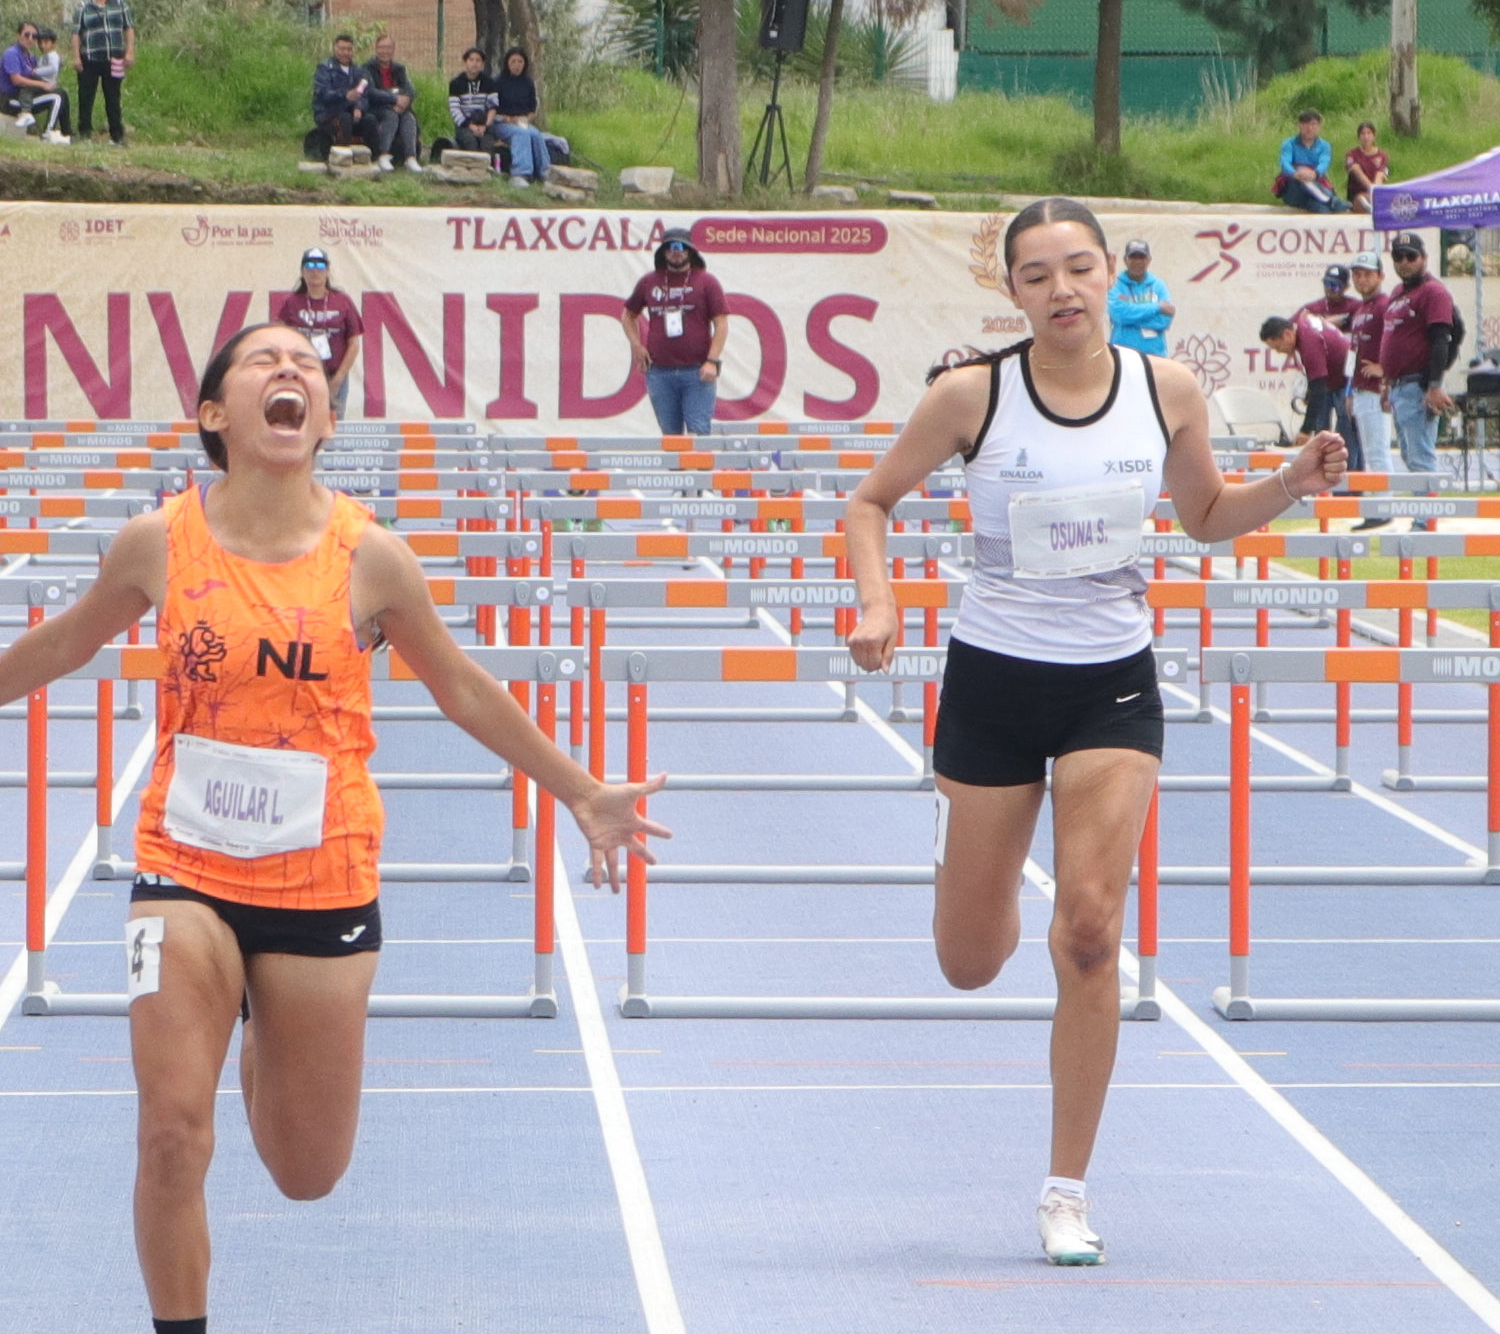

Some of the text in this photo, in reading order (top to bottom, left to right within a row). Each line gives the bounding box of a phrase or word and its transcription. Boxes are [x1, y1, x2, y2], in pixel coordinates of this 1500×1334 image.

[85, 219, 125, 233] IDET
[212, 226, 234, 238] Por
[252, 227, 274, 240] paz
[446, 216, 665, 251] TLAXCALA
[705, 227, 872, 244] Sede Nacional 2025
[807, 424, 850, 434] MONDO
[86, 436, 133, 446] MONDO
[343, 438, 390, 448] MONDO
[49, 454, 101, 465] MONDO
[332, 455, 384, 466] MONDO
[610, 456, 662, 467] MONDO
[1119, 459, 1153, 473] ISDE
[8, 474, 66, 486] MONDO
[1000, 470, 1044, 479] SINALOA
[323, 476, 380, 487] MONDO
[636, 476, 695, 487] MONDO
[671, 503, 737, 516] MONDO
[1390, 503, 1457, 516] MONDO
[1050, 518, 1108, 551] OSUNA S.
[723, 539, 799, 554] MONDO
[766, 587, 855, 604] MONDO
[1250, 588, 1339, 605] MONDO
[256, 638, 329, 682] NL
[203, 779, 284, 825] AGUILAR L.
